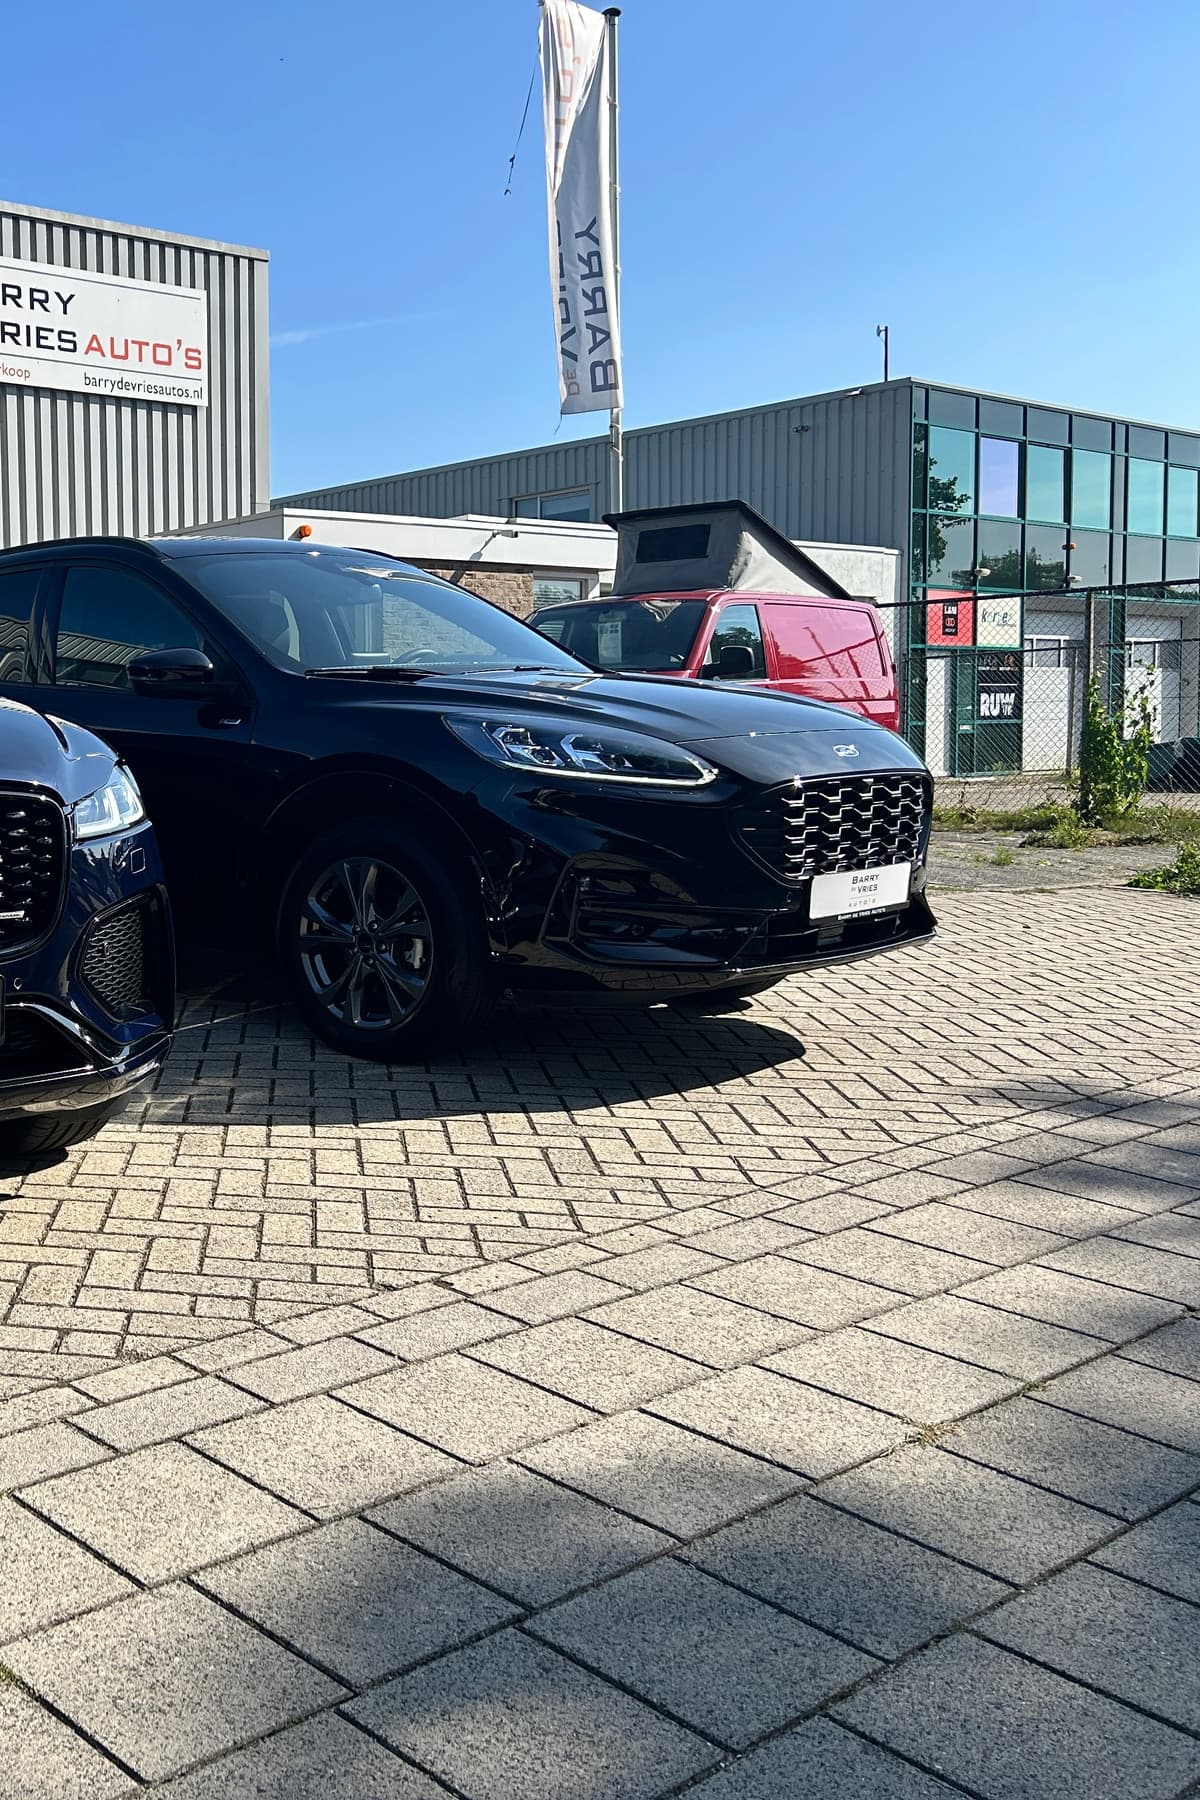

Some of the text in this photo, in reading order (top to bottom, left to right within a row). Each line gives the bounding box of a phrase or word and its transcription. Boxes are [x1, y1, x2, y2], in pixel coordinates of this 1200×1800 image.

[84, 333, 202, 370] AUTO'S
[84, 372, 203, 400] barrydevriesautos.nl
[852, 873, 880, 885] BARRY
[857, 884, 878, 893] VRIES
